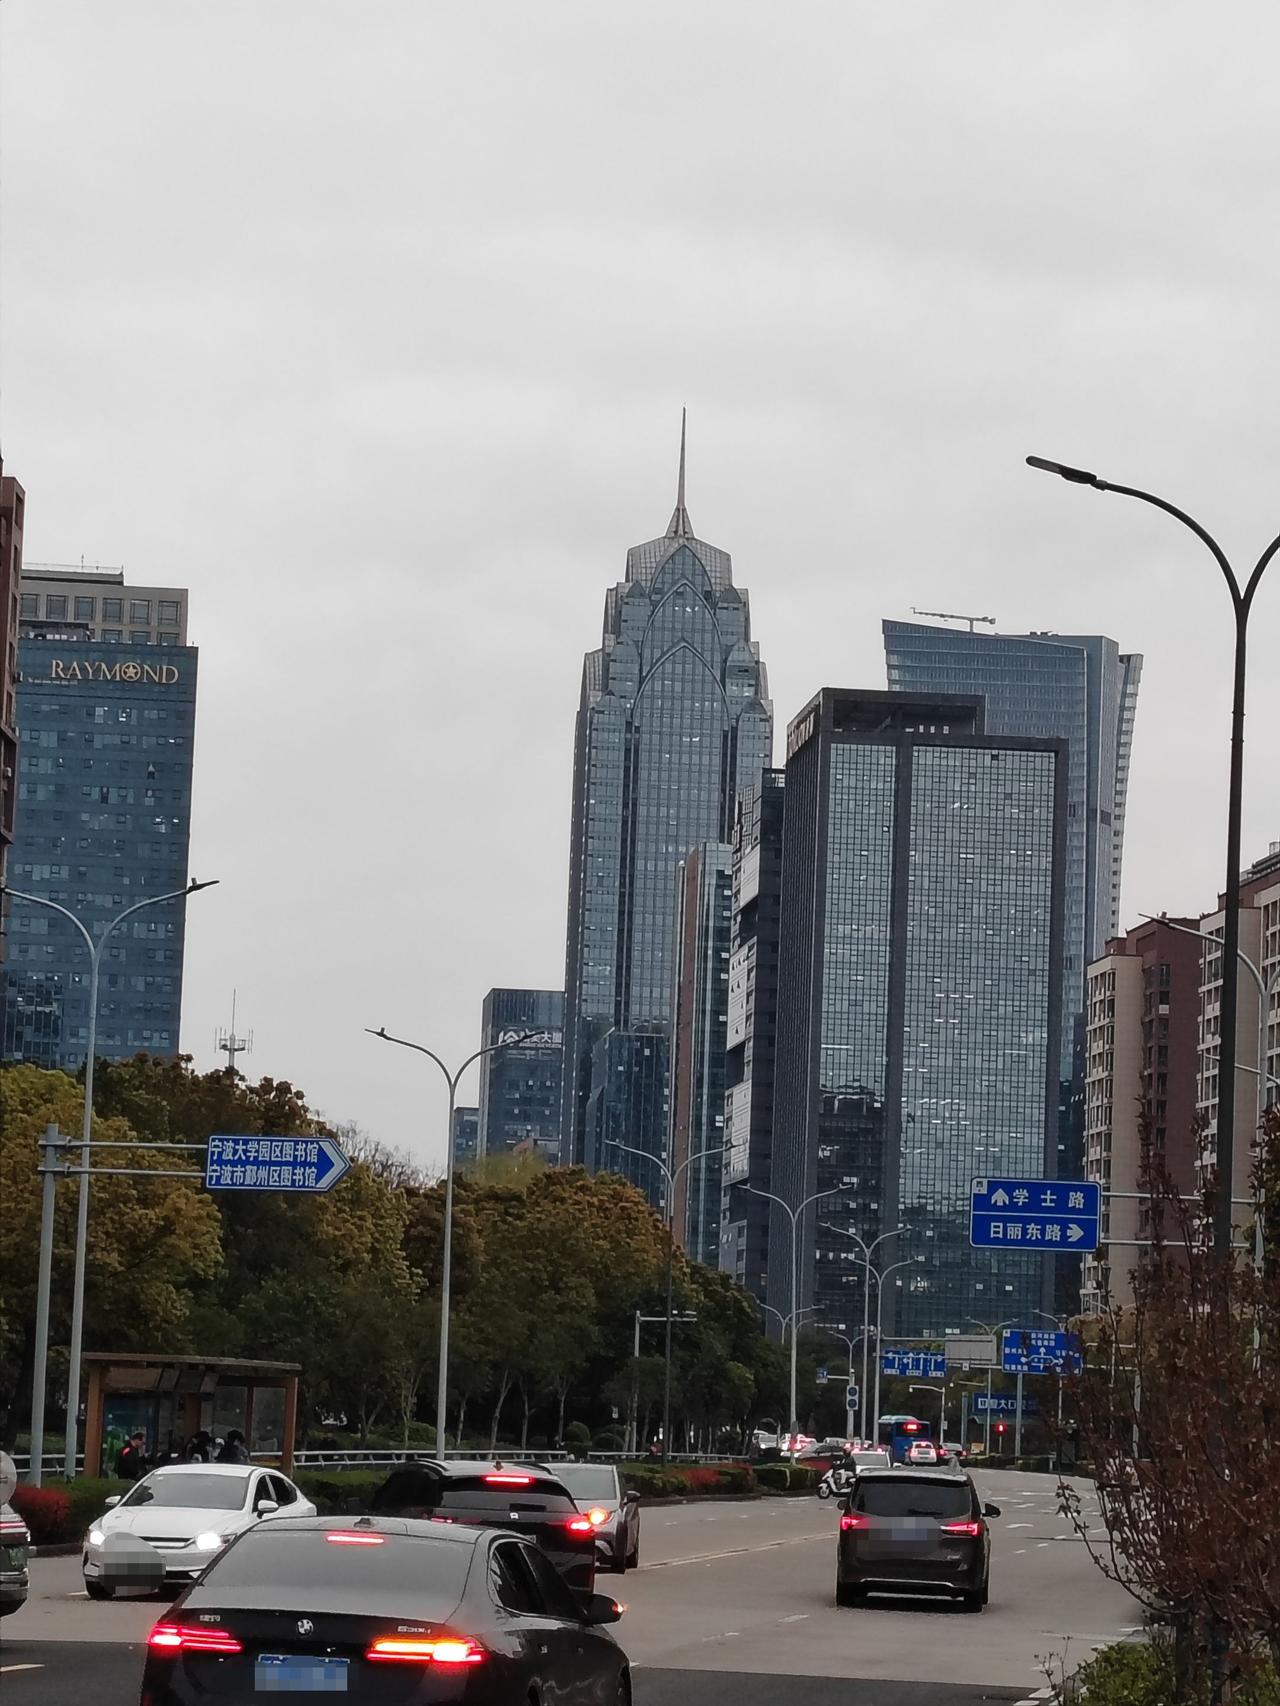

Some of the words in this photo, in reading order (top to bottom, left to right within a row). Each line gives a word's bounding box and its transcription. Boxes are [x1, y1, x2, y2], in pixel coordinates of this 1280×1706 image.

[51, 659, 179, 684] RAYMOND
[210, 1140, 319, 1163] 宁波大学园区图书馆
[208, 1164, 318, 1187] 宁波市鄞州区图书馆
[1012, 1188, 1085, 1209] 学士路
[990, 1222, 1061, 1242] 日丽东路
